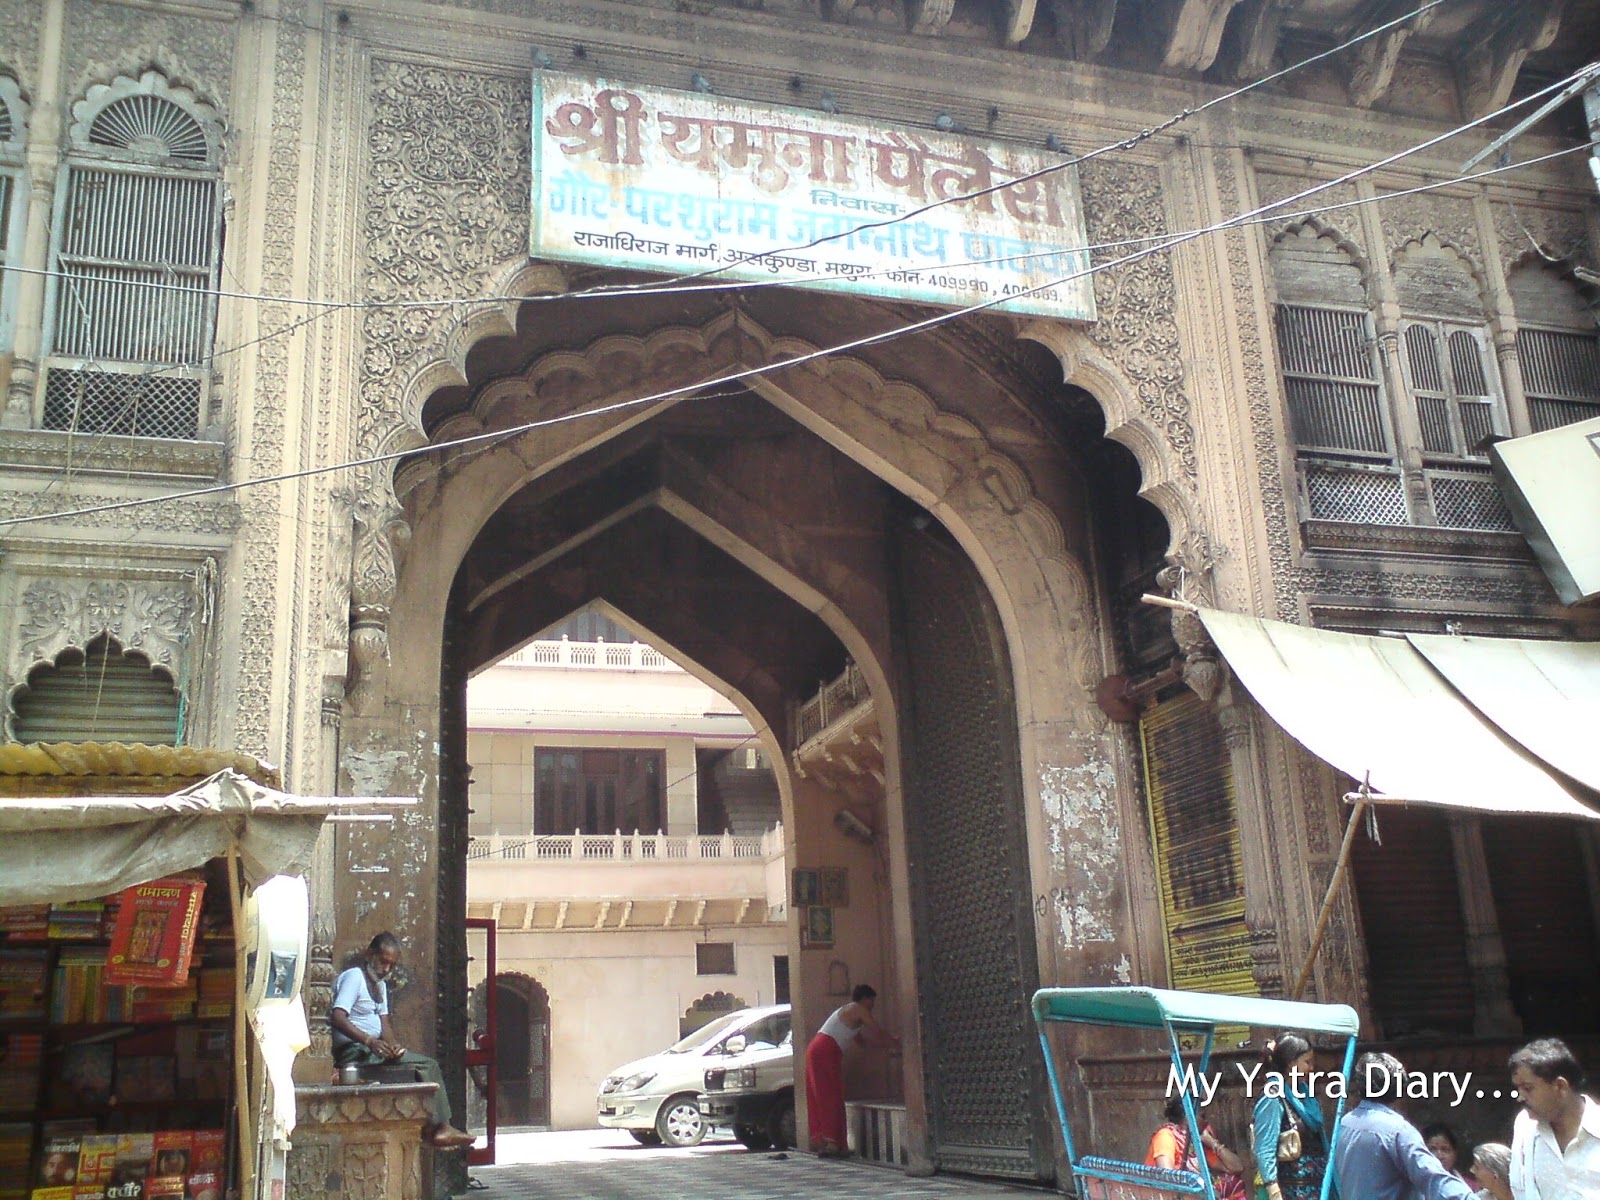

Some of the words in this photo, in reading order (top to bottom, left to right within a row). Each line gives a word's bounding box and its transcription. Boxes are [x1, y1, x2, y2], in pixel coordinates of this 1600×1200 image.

[545, 88, 648, 166] श्री
[658, 112, 855, 192] यमुना
[573, 231, 670, 256] राजाधिराज
